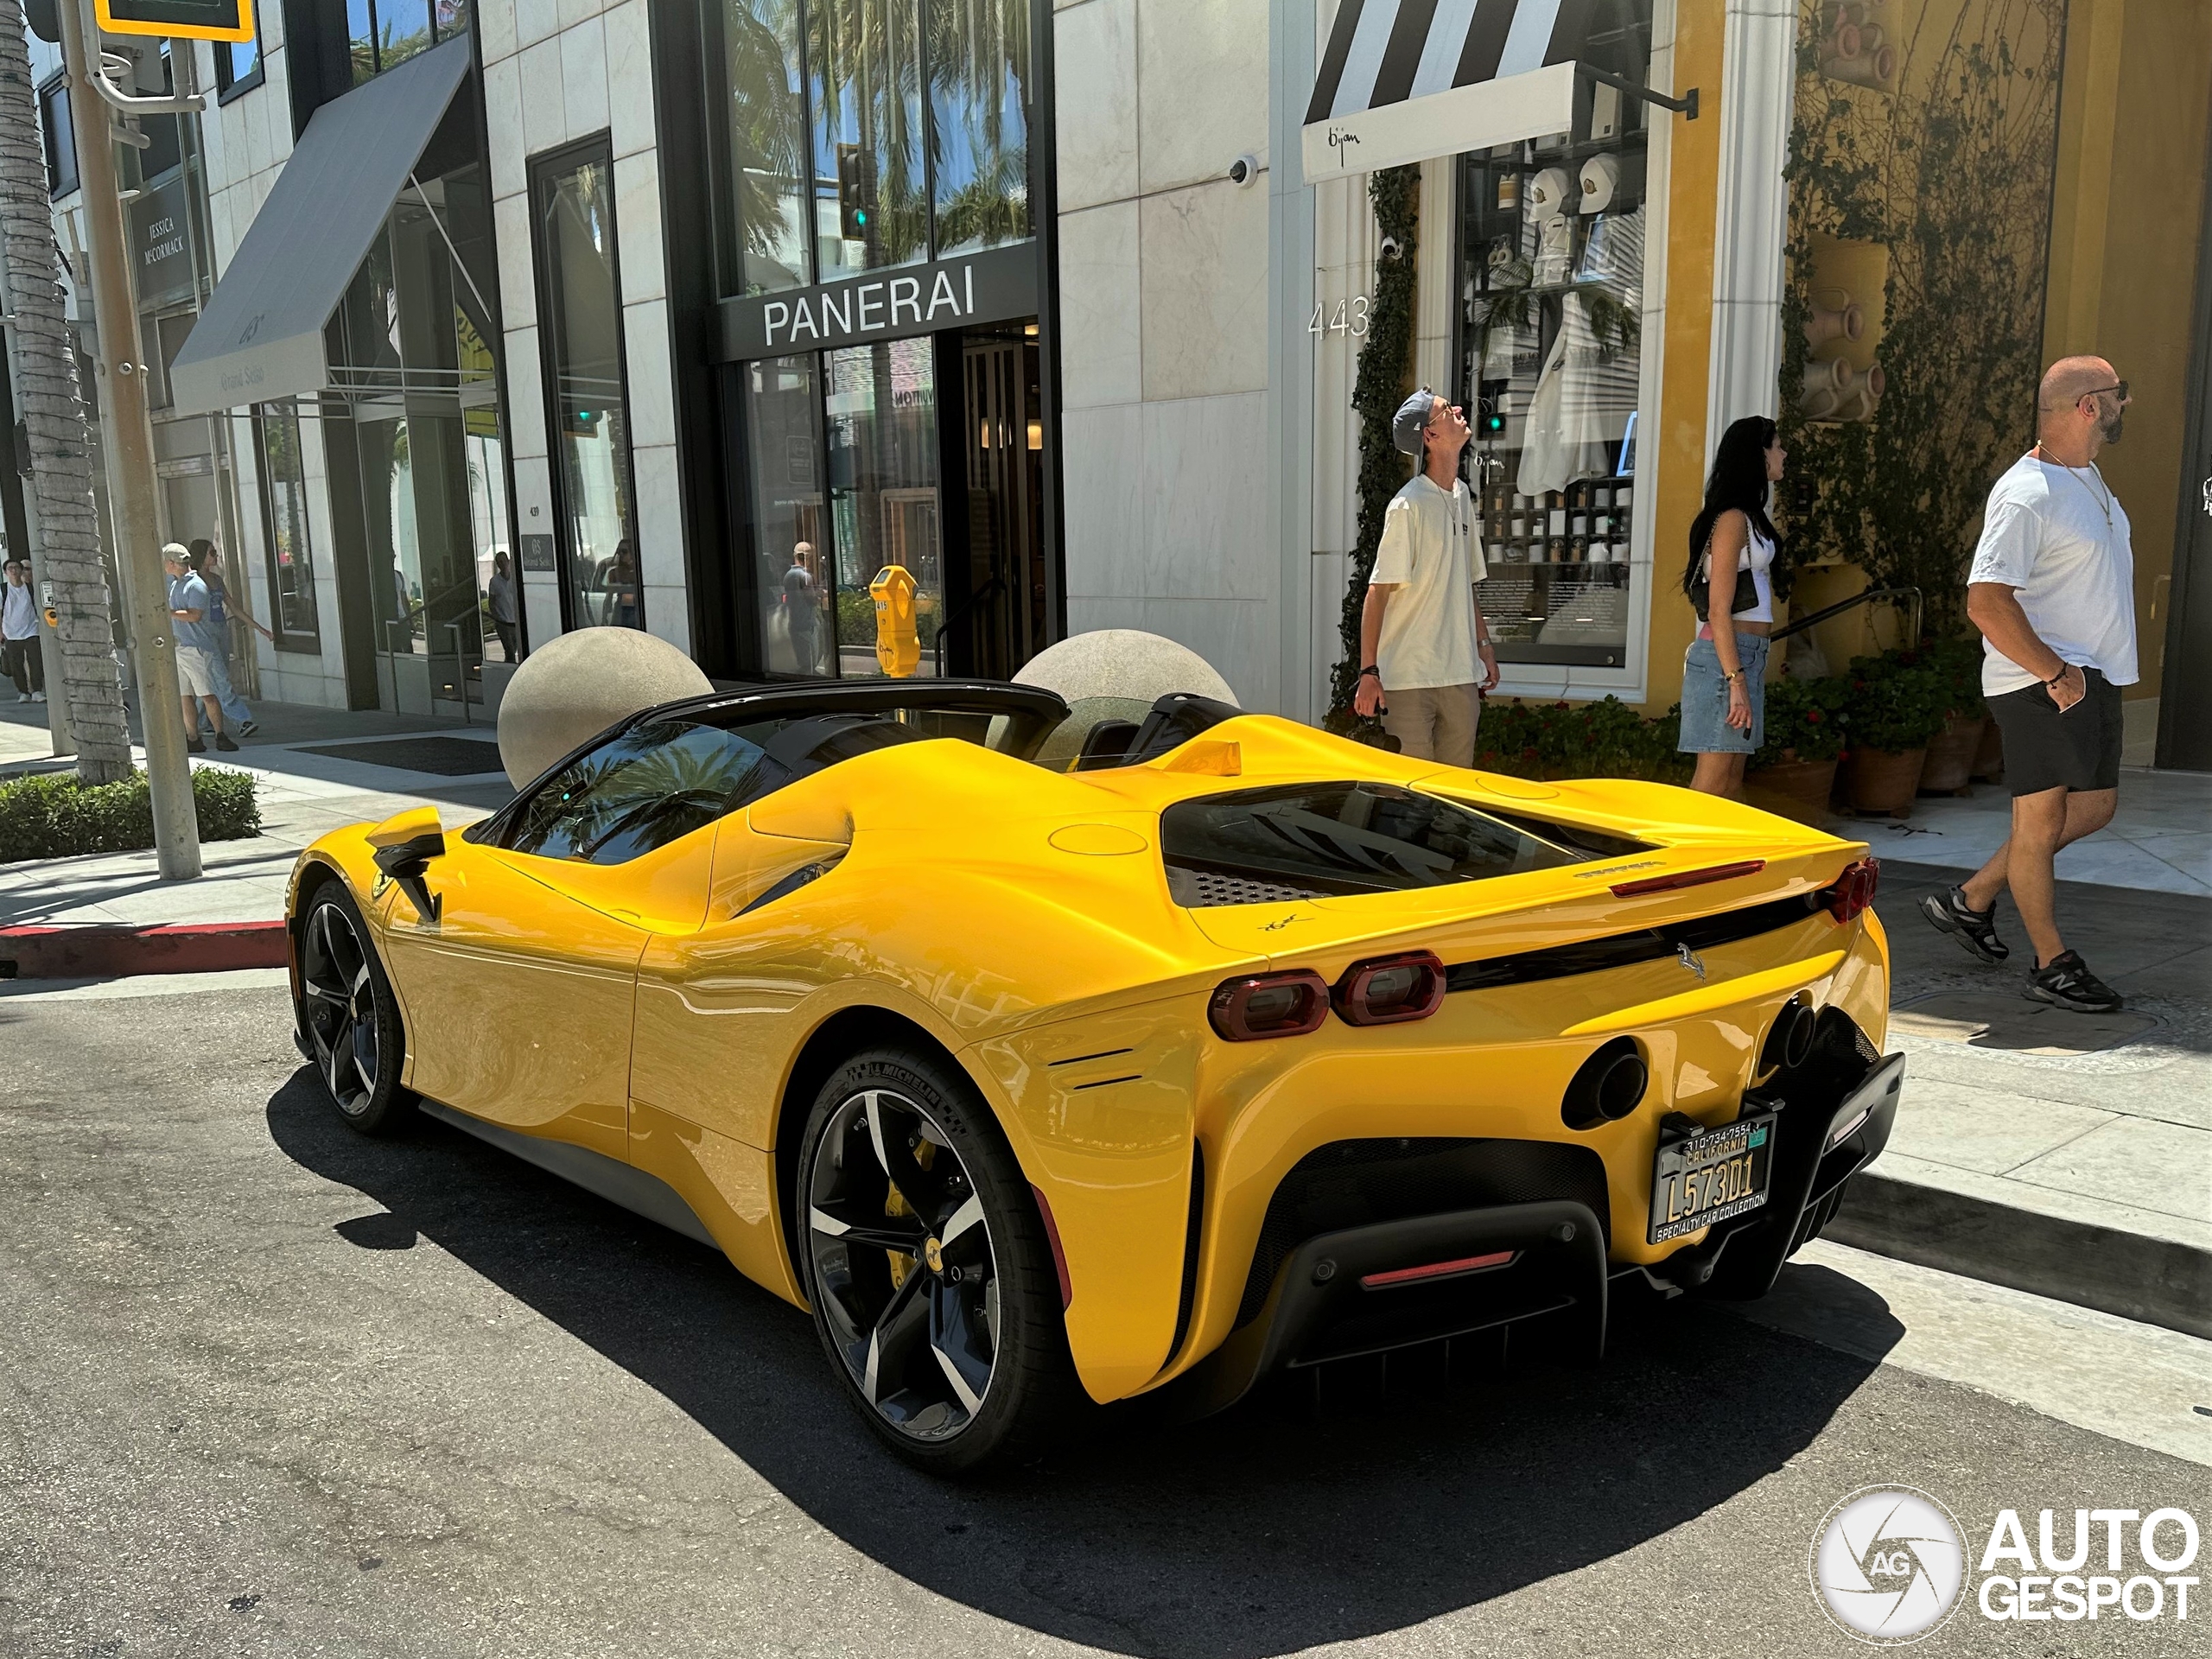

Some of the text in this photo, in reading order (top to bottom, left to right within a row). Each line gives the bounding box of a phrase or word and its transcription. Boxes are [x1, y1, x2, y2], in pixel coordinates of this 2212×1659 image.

[1328, 127, 1361, 169] bijan
[149, 216, 175, 243] JESSICA
[764, 265, 974, 346] PANERAI
[1307, 295, 1370, 340] 443
[876, 601, 887, 610] 415
[882, 1064, 941, 1105] MICHELIN
[1687, 1122, 1751, 1151] 310-734-7554
[1687, 1135, 1747, 1166] CALIFORNIA
[1667, 1151, 1753, 1224] L573D1
[1656, 1192, 1766, 1243] SPECIALTY CAR COLLECTION
